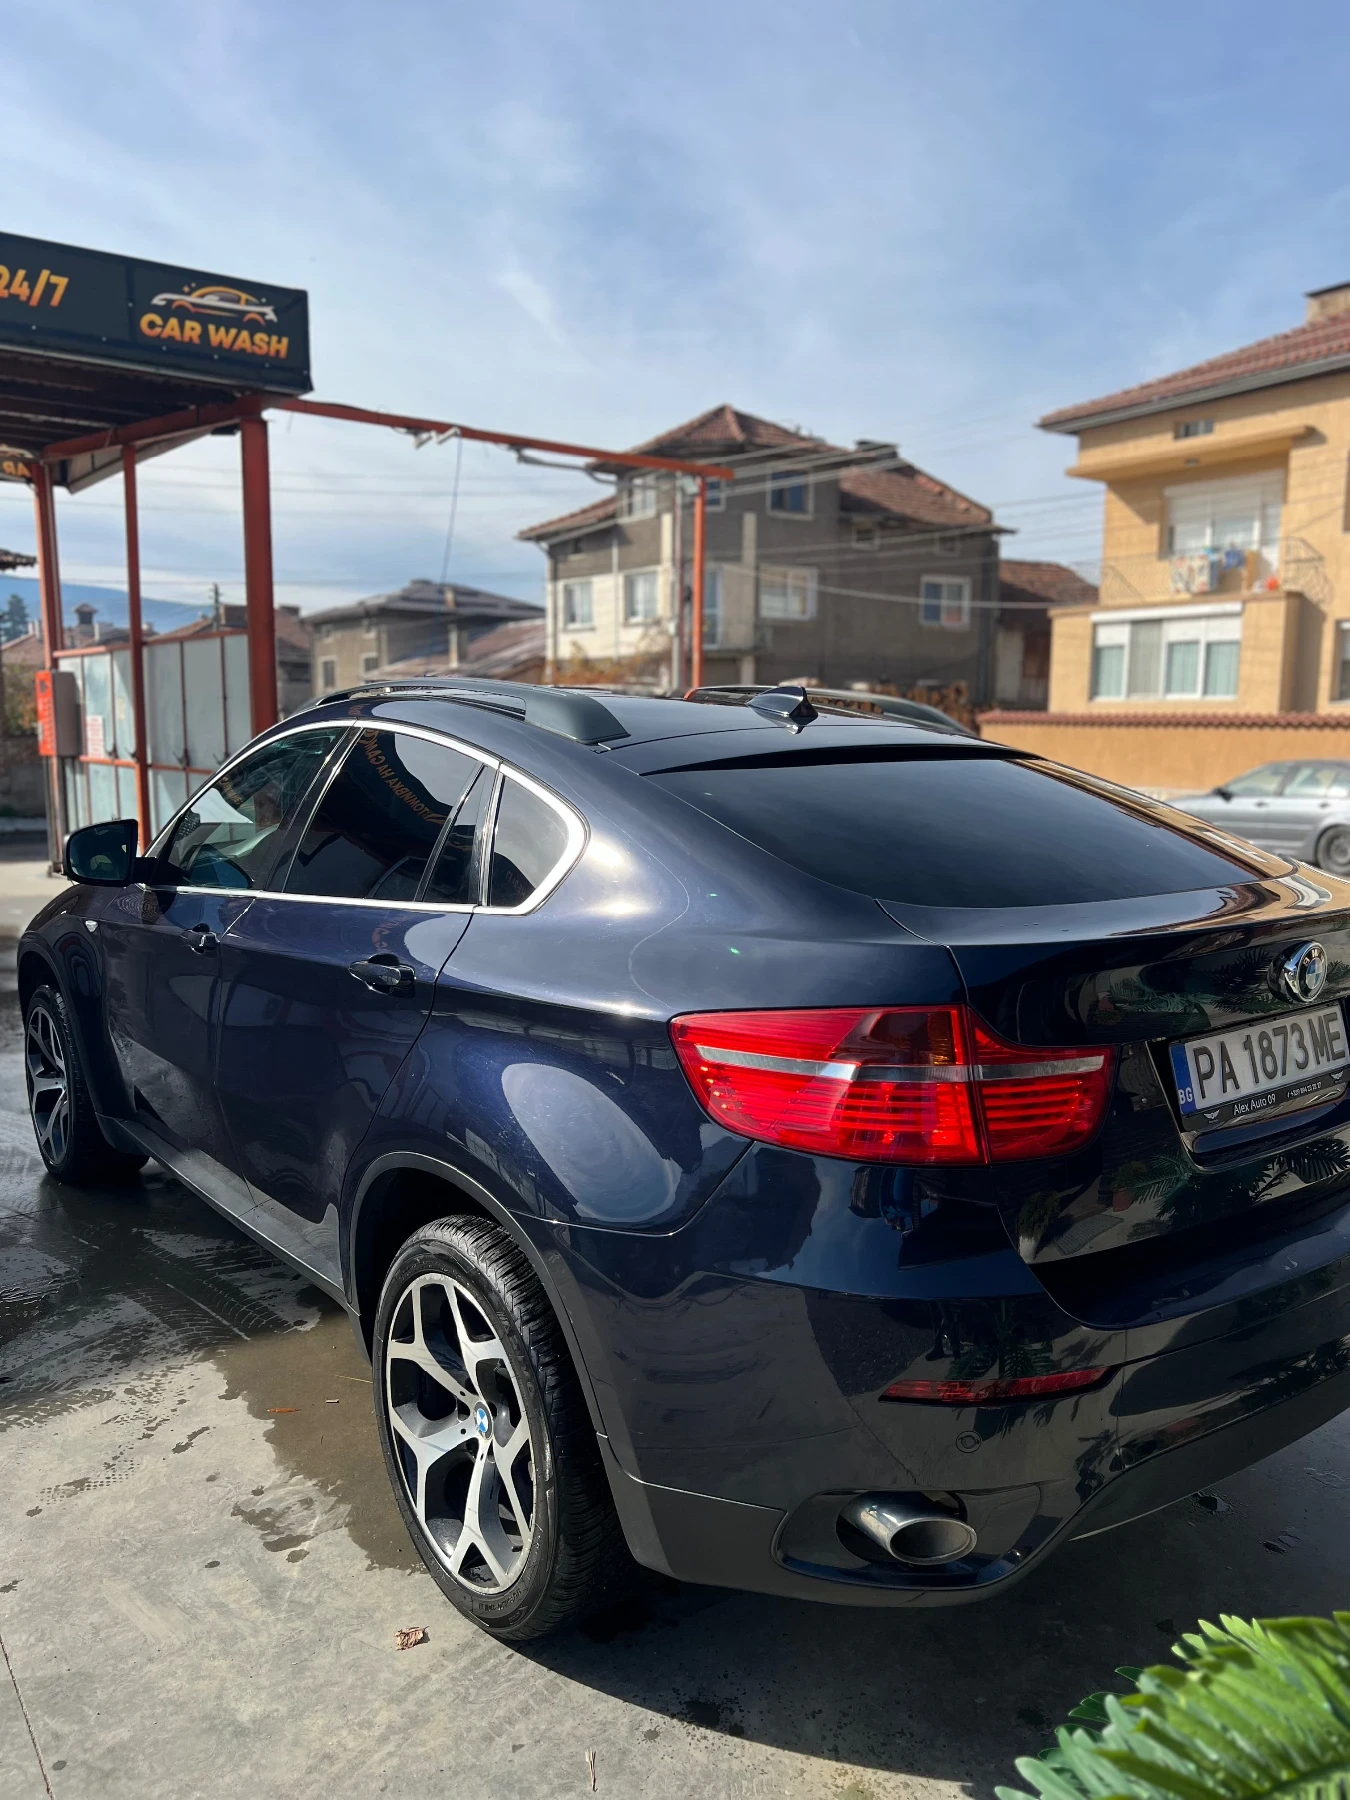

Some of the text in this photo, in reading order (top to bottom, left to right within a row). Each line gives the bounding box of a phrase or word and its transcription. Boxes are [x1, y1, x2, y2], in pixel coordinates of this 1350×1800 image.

[140, 313, 289, 358] CAR WASH
[1193, 1012, 1346, 1099] PA 1873 ME
[1179, 1088, 1193, 1105] BG
[1233, 1093, 1276, 1116] Alex Auto 09
